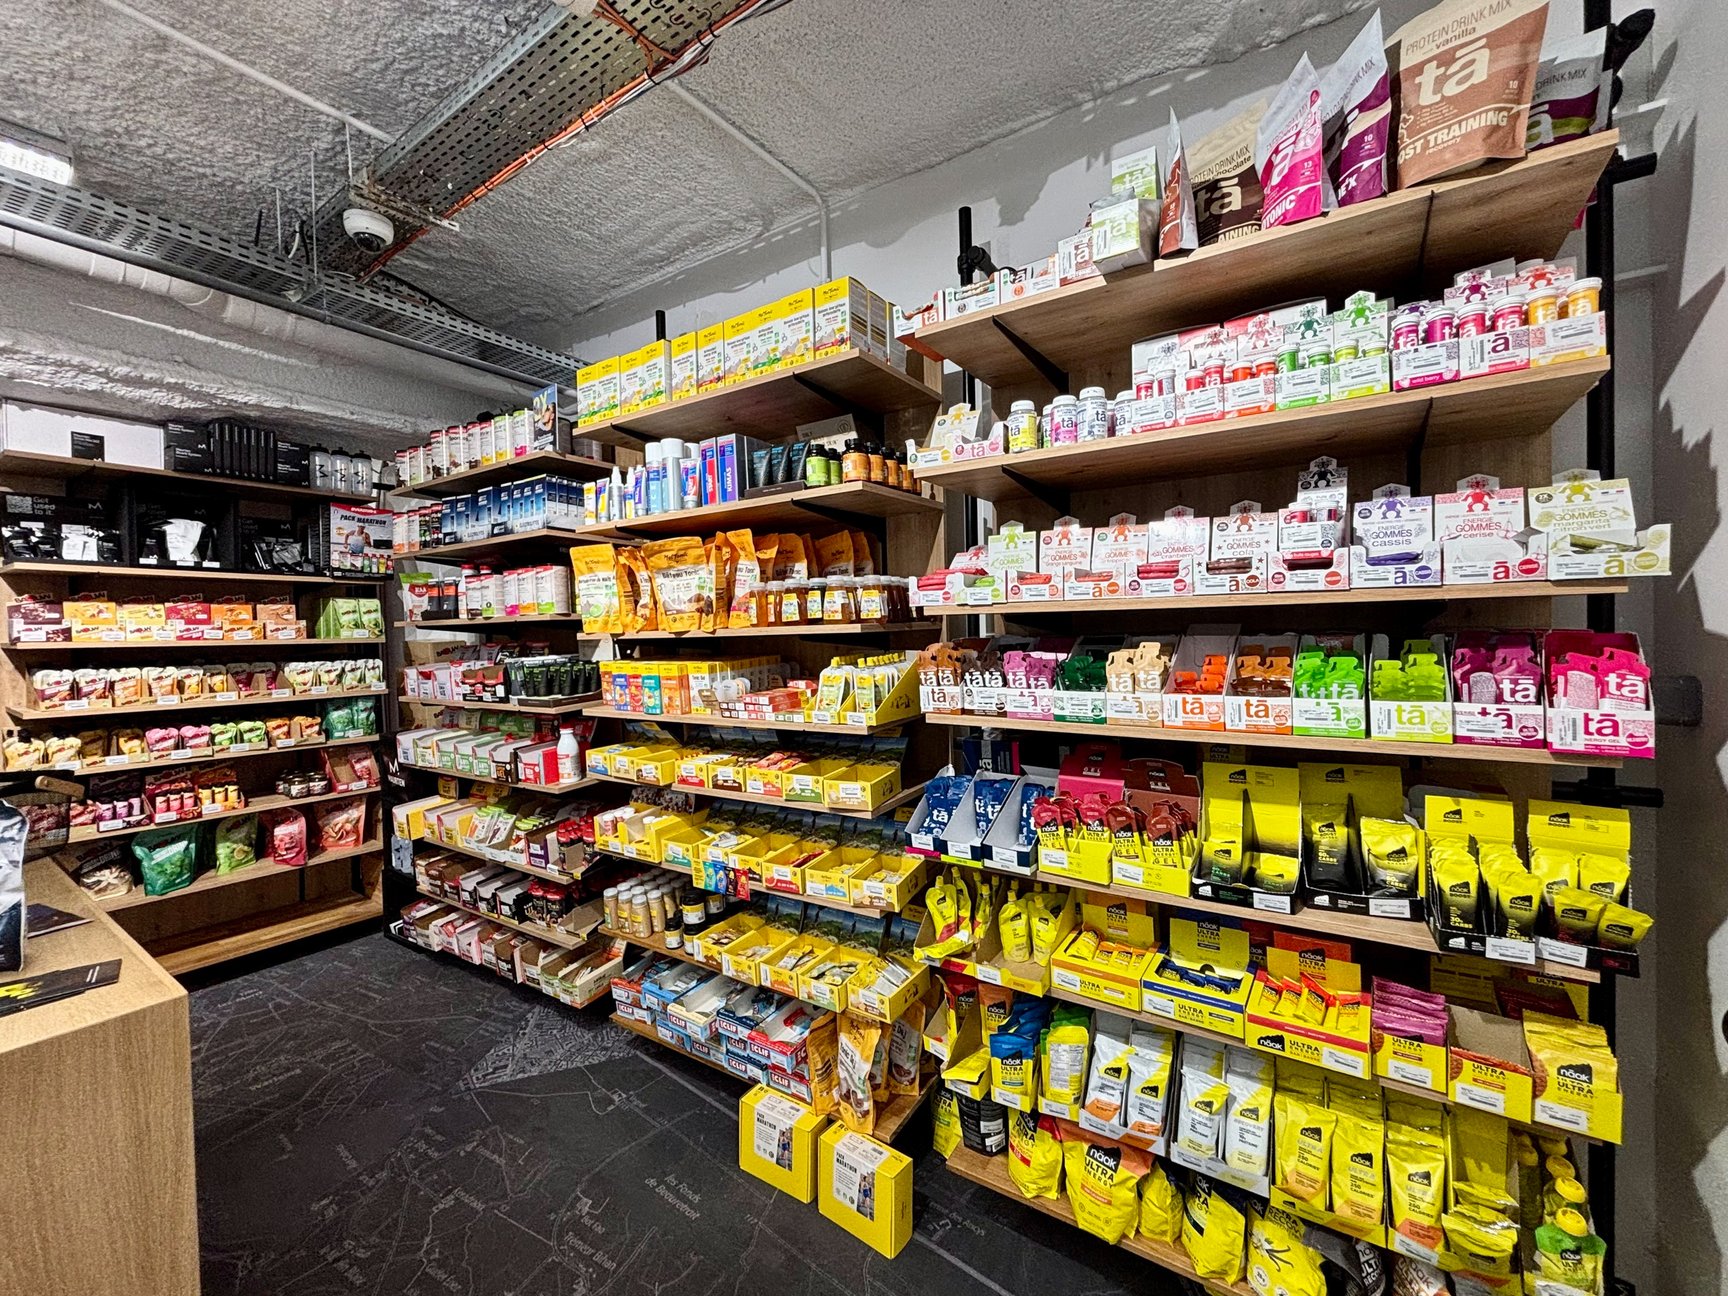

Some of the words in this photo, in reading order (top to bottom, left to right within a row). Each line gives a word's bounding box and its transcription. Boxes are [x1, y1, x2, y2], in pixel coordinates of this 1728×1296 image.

[1406, 26, 1449, 56] PROTEIN
[1452, 9, 1489, 33] DRINK
[1435, 27, 1476, 50] vanilla
[1429, 110, 1509, 146] TRAINING
[340, 514, 356, 522] PACK
[357, 517, 387, 526] MARATHON
[1555, 511, 1607, 522] GOMMES
[1455, 522, 1502, 533] GOMMES
[1371, 530, 1412, 540] GOMMES
[1463, 531, 1494, 539] cerise
[1163, 545, 1194, 553] GOMMES
[1226, 541, 1260, 550] GOMMES
[1371, 539, 1412, 547] cassis
[1051, 553, 1078, 561] GOMMES
[1232, 549, 1254, 557] cola
[1499, 676, 1536, 703] tā
[1605, 673, 1645, 698] tā
[932, 686, 947, 704] tā
[1181, 697, 1204, 716] tā
[1245, 700, 1270, 719] tā
[1395, 704, 1426, 725] tā
[1584, 713, 1619, 736] tā
[1041, 833, 1060, 841] ULTRA
[1153, 857, 1177, 866] GEL
[1106, 913, 1127, 921] ULTRA
[1197, 929, 1221, 938] ULTRA
[1298, 958, 1325, 968] ULTRA
[1080, 980, 1100, 989] ULTRA
[1536, 977, 1565, 988] ULTRA
[620, 1005, 634, 1016] CLIF
[1178, 1003, 1204, 1015] ULTRA
[672, 1015, 688, 1029] CLIF
[987, 1012, 1007, 1023] ULTRA
[722, 1021, 738, 1034] CLIF
[1289, 1040, 1320, 1053] ULTRA
[1392, 1036, 1423, 1050] ULTRA
[753, 1046, 770, 1058] CLIF
[731, 1060, 747, 1072] CLIF
[1000, 1065, 1024, 1073] ULTRA
[1472, 1062, 1507, 1077] ULTRA
[772, 1073, 789, 1087] CLIF
[1557, 1081, 1594, 1095] ULTRA
[757, 1117, 777, 1131] MARATHON
[836, 1157, 858, 1175] MARATHON
[1089, 1149, 1118, 1172] näak
[1085, 1158, 1115, 1183] ULTRA
[644, 1177, 657, 1188] de
[676, 1183, 702, 1204] Fonds
